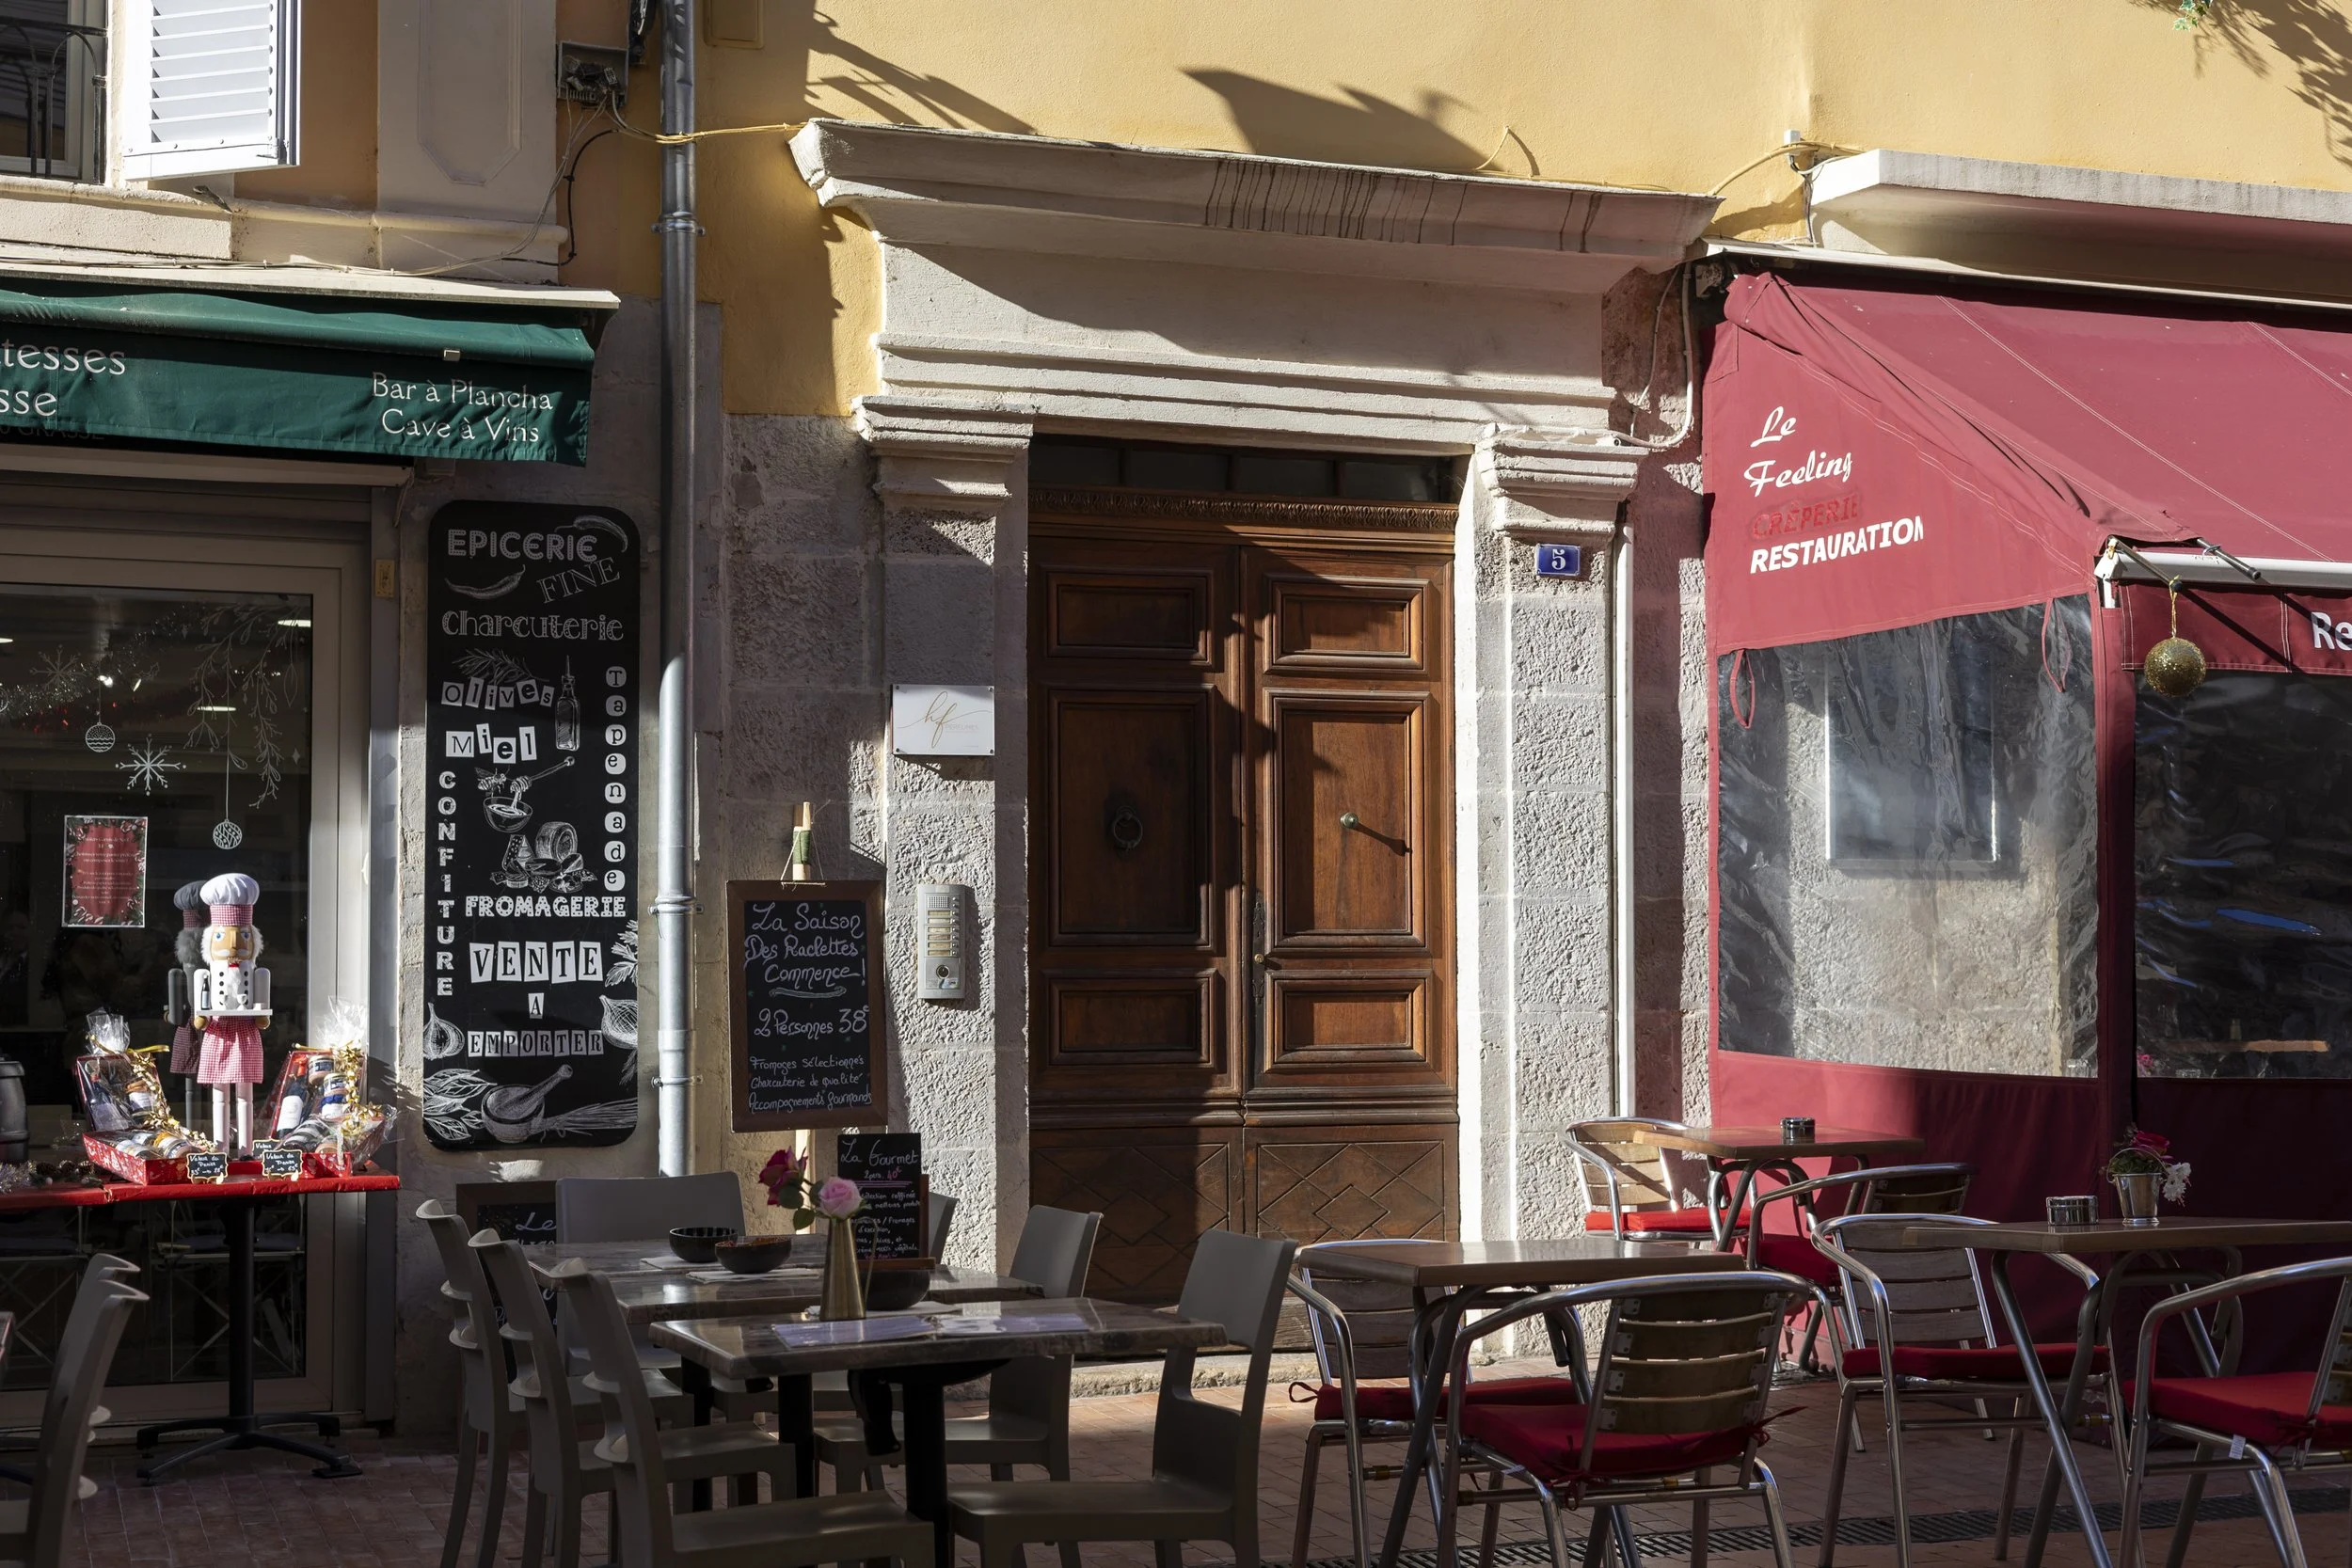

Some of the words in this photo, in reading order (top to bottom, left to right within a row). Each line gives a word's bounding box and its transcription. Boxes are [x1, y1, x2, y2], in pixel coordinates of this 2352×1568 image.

[372, 372, 417, 402] Bar
[426, 378, 441, 404] à
[451, 380, 554, 411] Plancha
[381, 408, 451, 438] Cave
[459, 410, 473, 441] à
[485, 415, 540, 443] Vins
[1750, 405, 1797, 448] Le
[1743, 450, 1852, 498] Feeling
[447, 529, 597, 562] EPICERIE
[1551, 548, 1566, 570] 5
[1750, 515, 1924, 574] RESTAURATION
[536, 557, 621, 604] FINE
[441, 610, 625, 641] Charcuterie
[442, 678, 554, 709] Olives
[447, 723, 536, 763] Miel
[437, 770, 456, 996] CONFITURE
[465, 895, 626, 917] FROMAGERIE
[752, 901, 787, 932] La
[794, 902, 864, 939] Saison
[470, 942, 602, 983] VENTE
[744, 935, 778, 970] Des
[784, 933, 858, 960] Raclettes
[529, 993, 544, 1016] A
[754, 1007, 771, 1037] 2
[773, 1009, 834, 1039] Personnes
[468, 1031, 603, 1057] EMPORTER
[750, 1056, 797, 1075] Fromages
[751, 1075, 805, 1089] Charcuterie
[809, 1073, 818, 1086] de
[841, 1138, 862, 1164] La
[868, 1139, 919, 1166] Gourmet
[516, 1212, 556, 1231] Le
